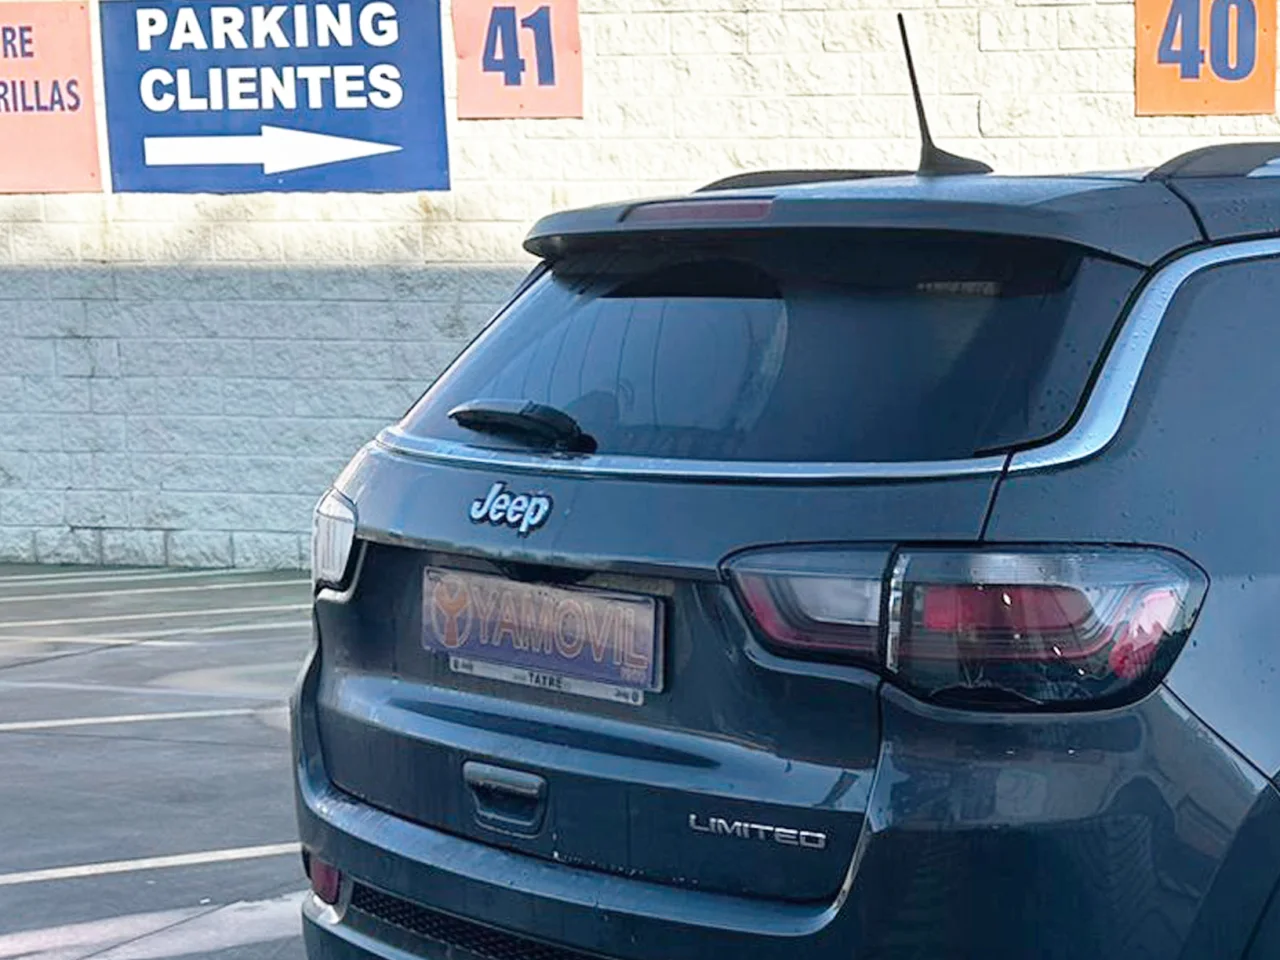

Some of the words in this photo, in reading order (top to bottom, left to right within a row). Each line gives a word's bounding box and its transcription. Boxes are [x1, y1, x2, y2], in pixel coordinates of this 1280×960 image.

[1, 25, 35, 59] RE
[136, 1, 399, 51] PARKING
[482, 5, 555, 87] 41
[1158, 0, 1257, 80] 40
[139, 63, 404, 112] CLIENTES
[470, 482, 552, 535] Jeep
[472, 585, 649, 669] YAMOVIL
[688, 813, 827, 849] LIMITED
